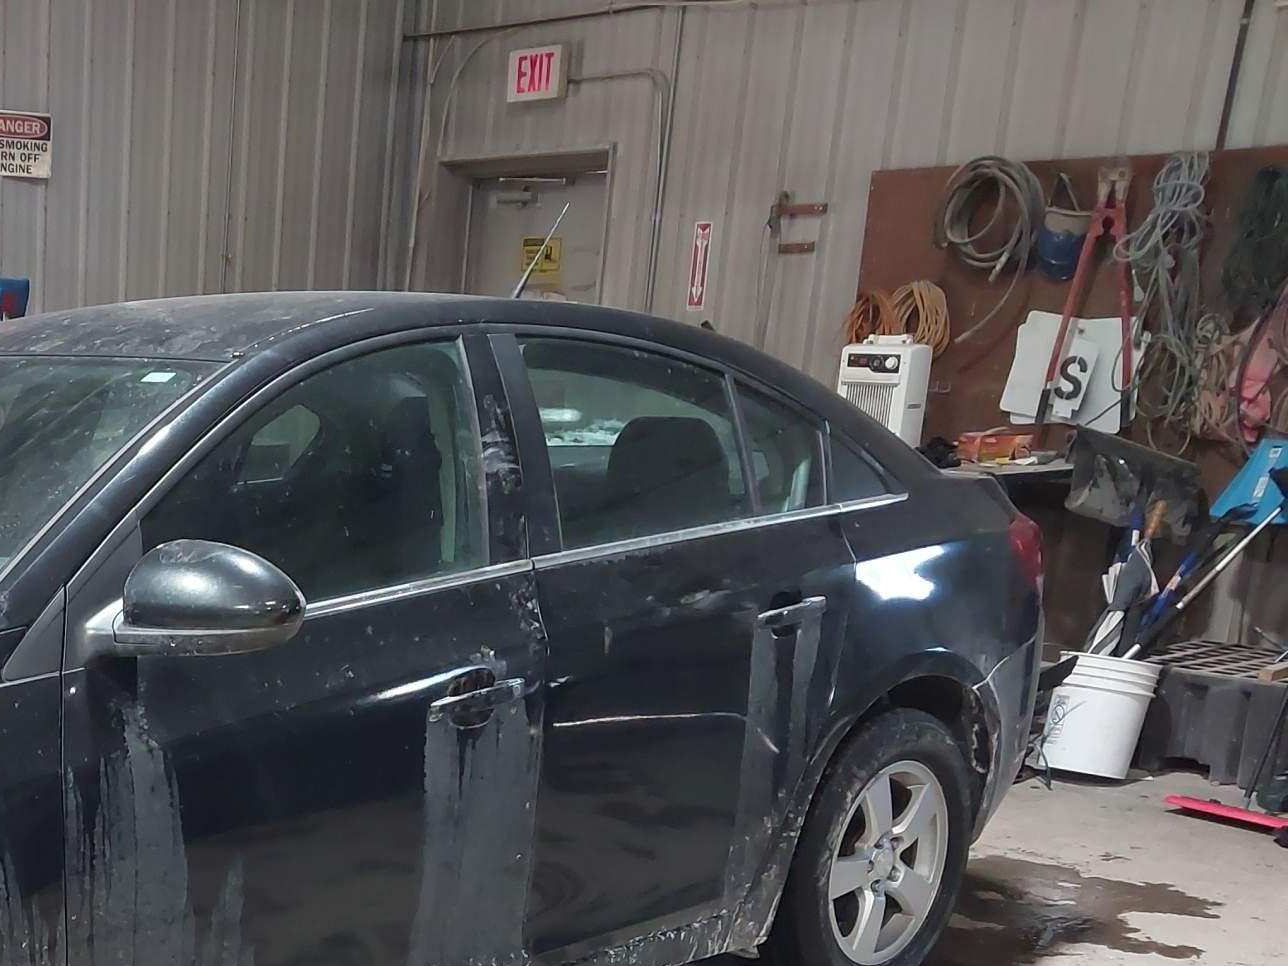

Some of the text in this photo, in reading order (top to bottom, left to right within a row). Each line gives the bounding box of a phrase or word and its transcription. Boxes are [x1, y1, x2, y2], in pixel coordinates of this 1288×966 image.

[516, 51, 554, 94] EXIT
[20, 152, 41, 163] OFF
[1054, 355, 1088, 400] S
